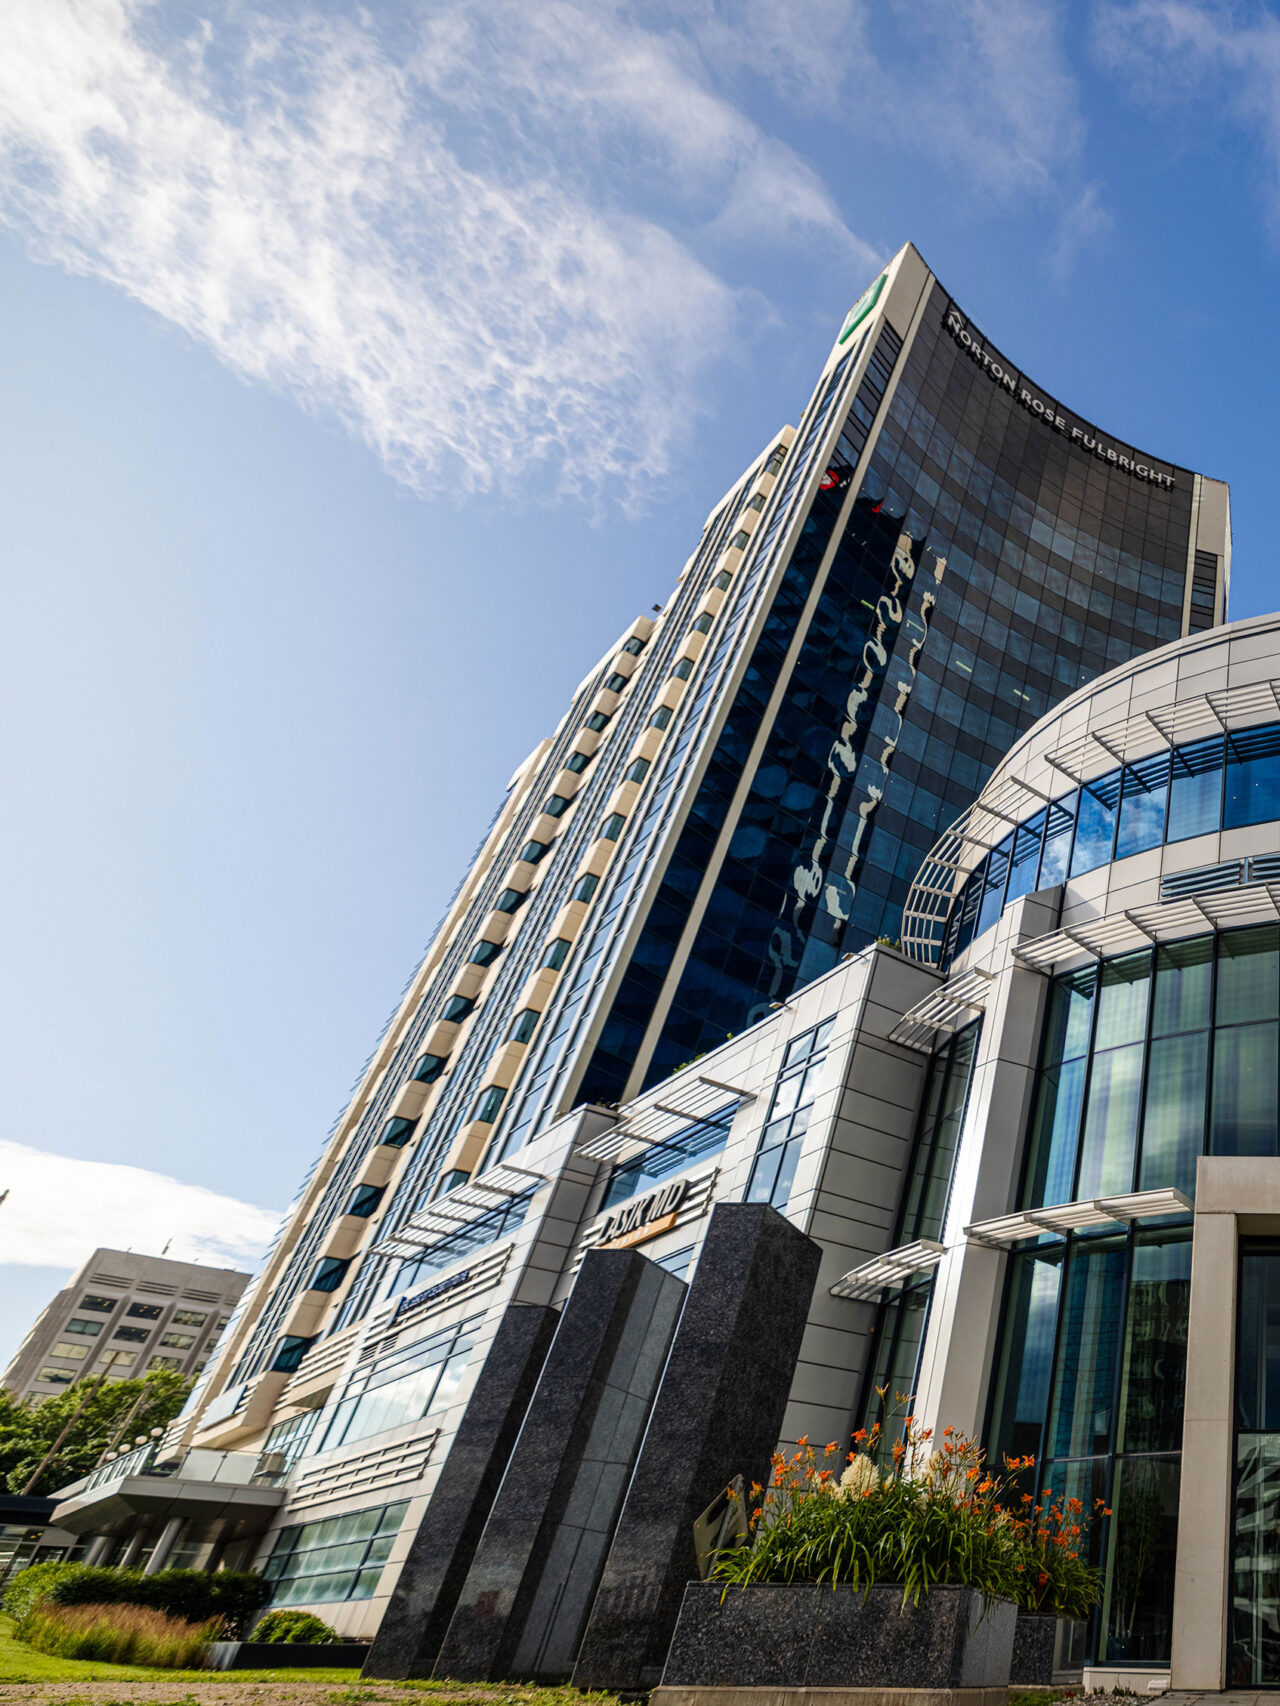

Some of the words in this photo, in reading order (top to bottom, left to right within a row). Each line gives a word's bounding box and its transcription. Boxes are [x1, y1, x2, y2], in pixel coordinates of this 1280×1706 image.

[947, 315, 1017, 391] NORTON
[1021, 388, 1066, 430] ROSE
[1071, 427, 1176, 487] FULBRIGHT
[594, 1197, 653, 1247] LASIK
[645, 1179, 688, 1223] MD
